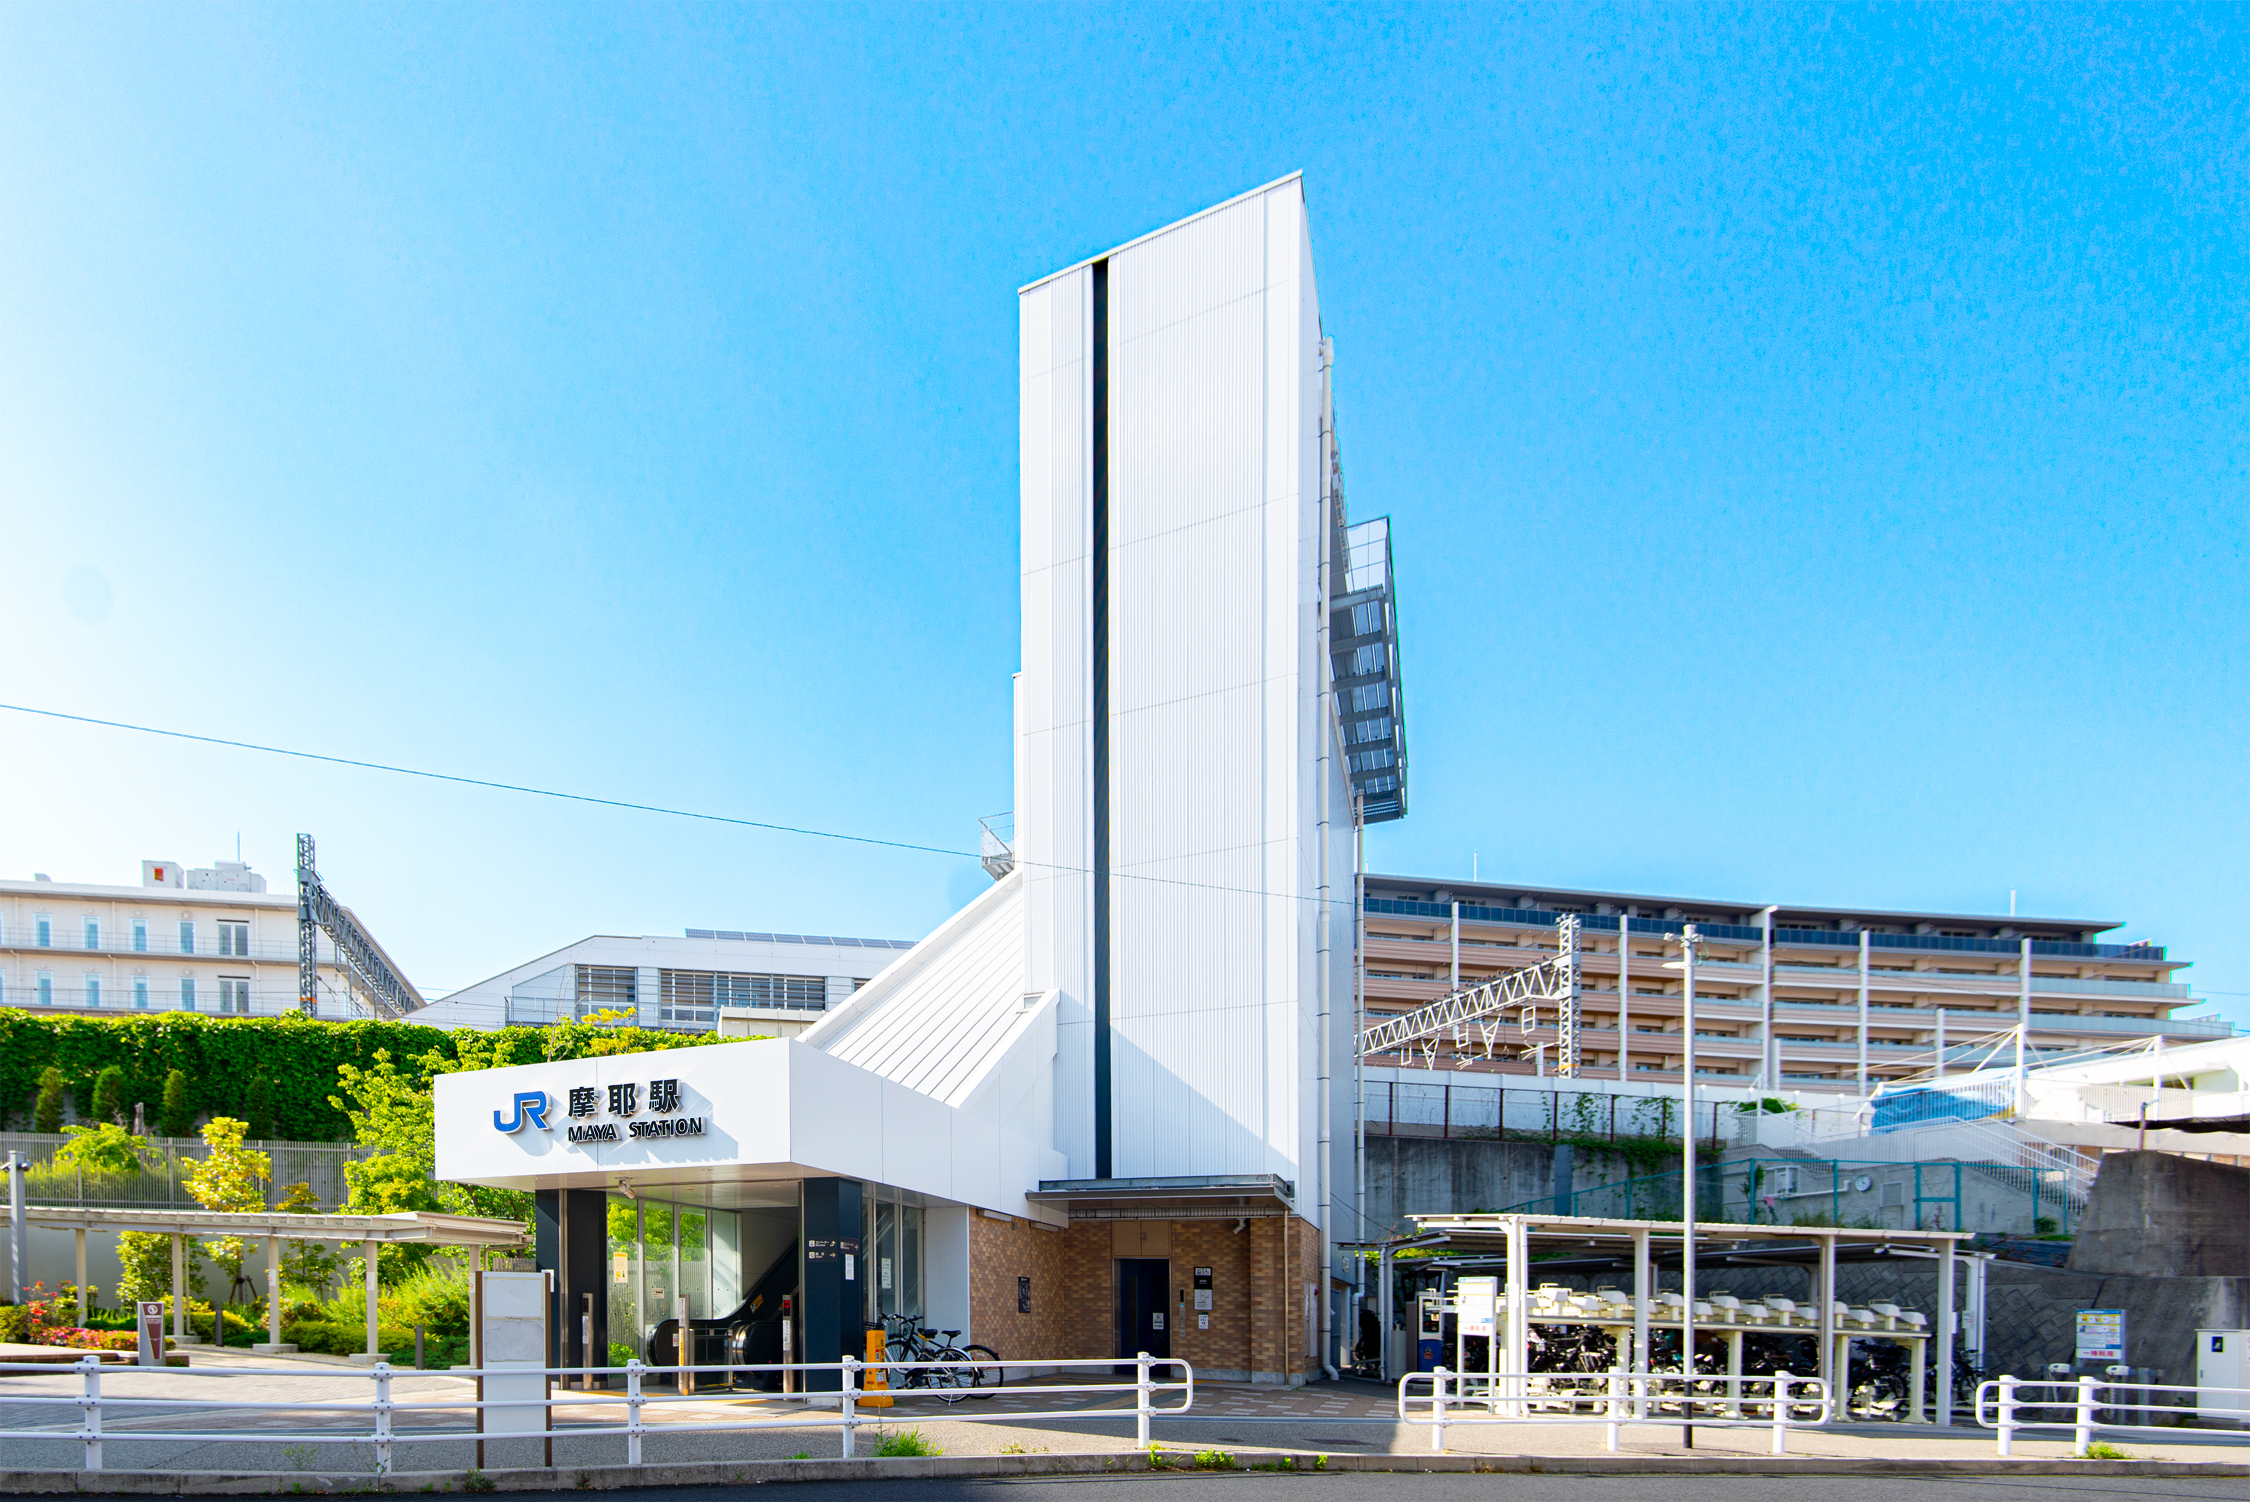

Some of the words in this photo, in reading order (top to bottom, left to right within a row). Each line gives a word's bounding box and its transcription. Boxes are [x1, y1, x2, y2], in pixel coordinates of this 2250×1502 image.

[493, 1090, 549, 1133] JR
[568, 1079, 680, 1118] 摩耶駅
[568, 1123, 618, 1142] MAYA
[628, 1117, 703, 1139] STATION
